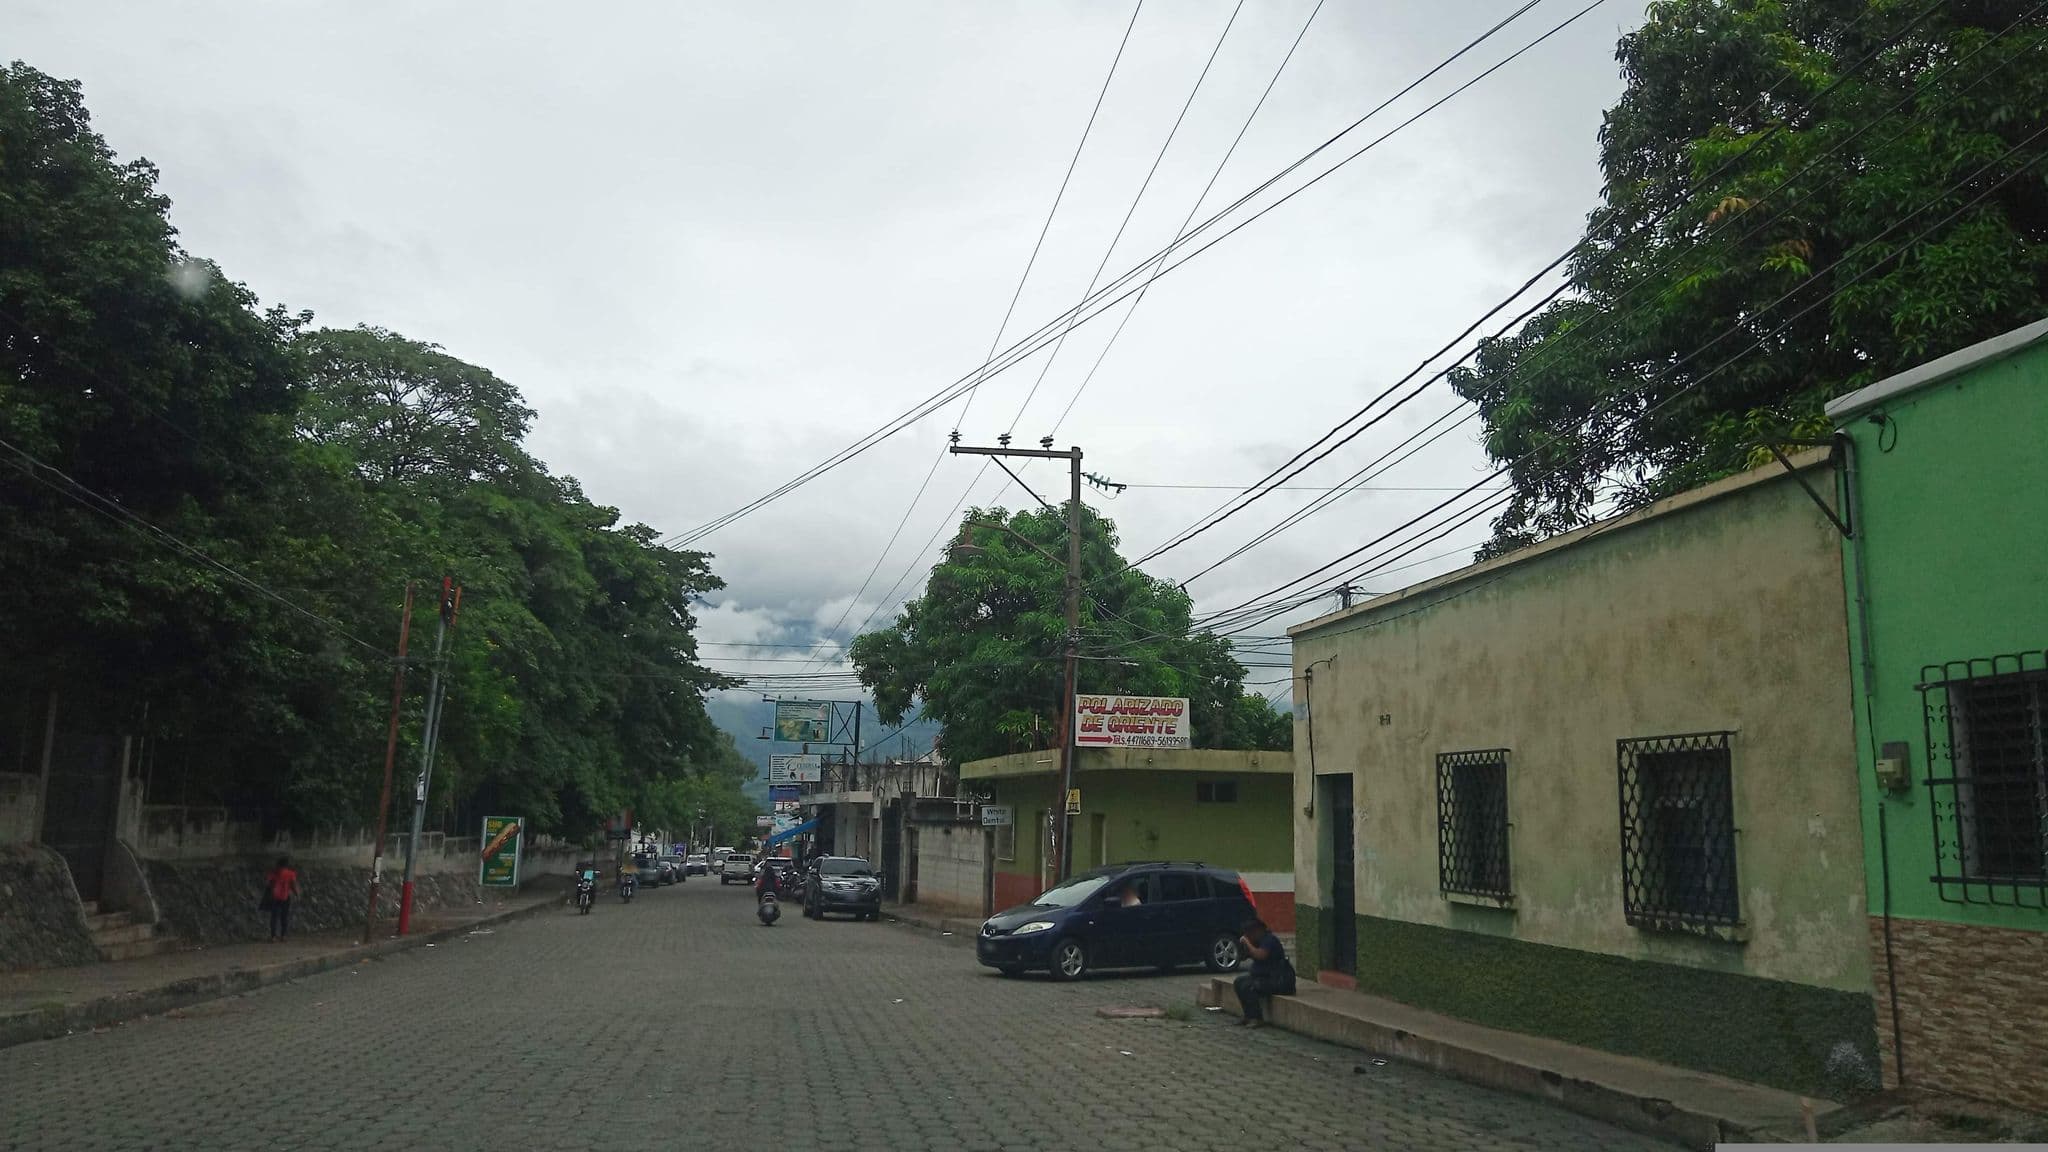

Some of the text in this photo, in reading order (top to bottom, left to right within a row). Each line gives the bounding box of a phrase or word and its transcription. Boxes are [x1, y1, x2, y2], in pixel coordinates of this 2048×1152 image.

[1078, 697, 1184, 717] POLARIZADO
[1081, 715, 1178, 735] DE ORIENTE
